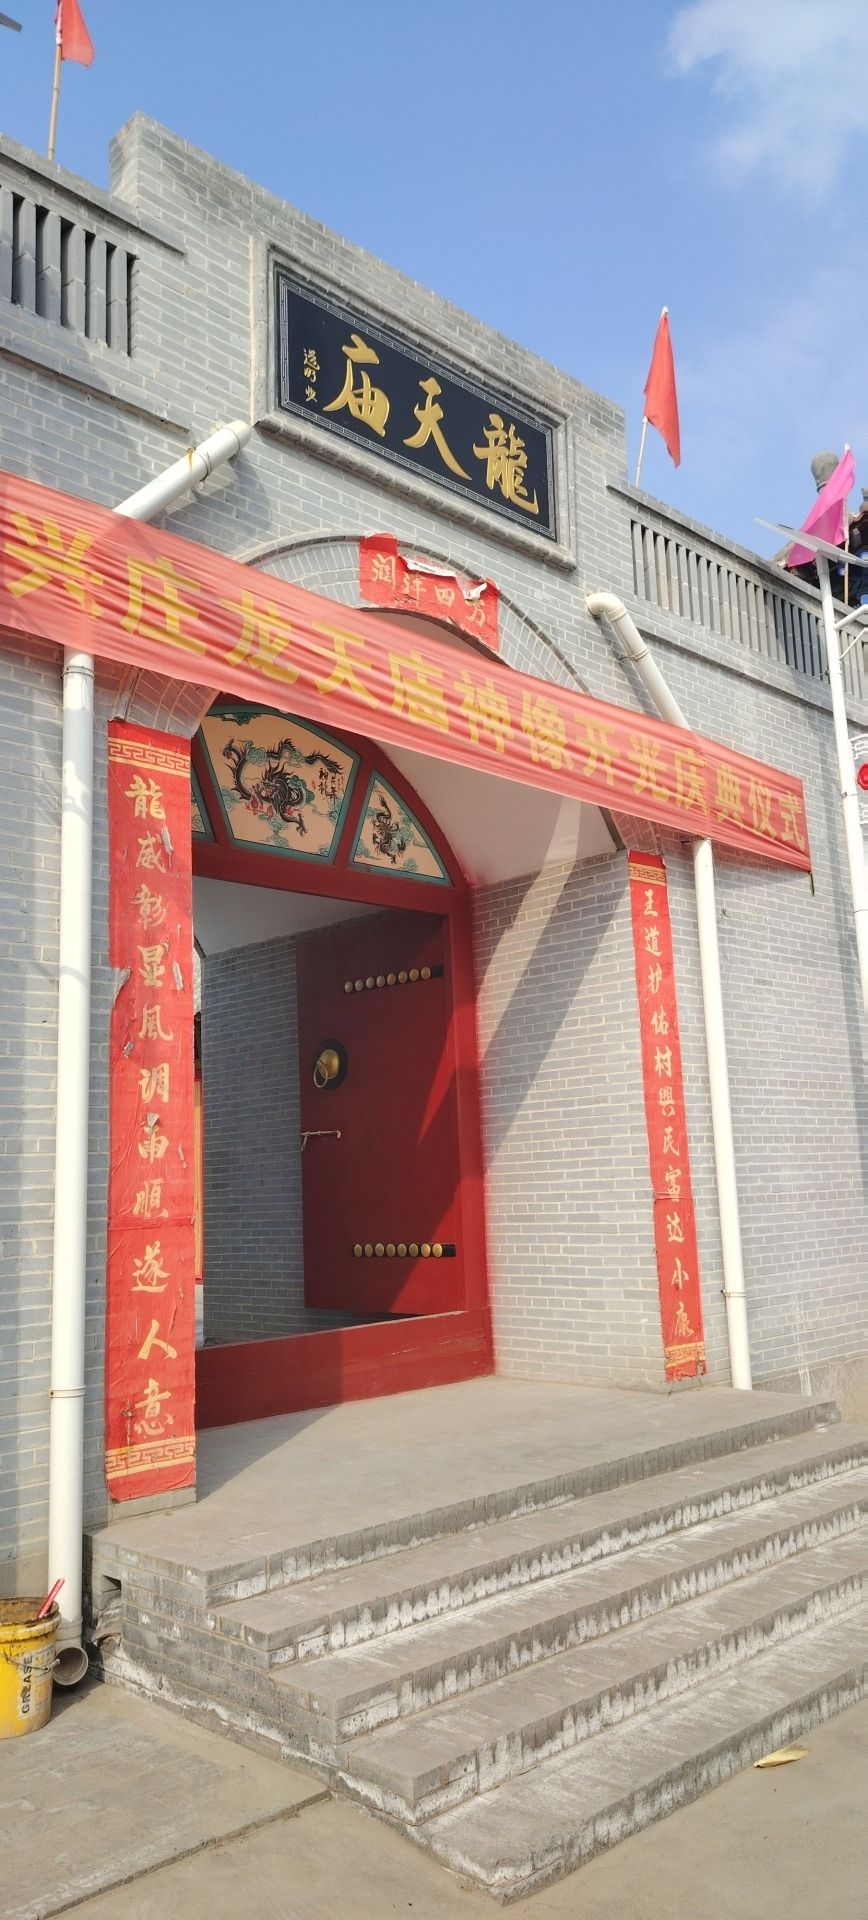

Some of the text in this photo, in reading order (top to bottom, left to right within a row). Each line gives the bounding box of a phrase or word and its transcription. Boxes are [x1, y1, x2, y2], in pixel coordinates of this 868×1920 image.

[322, 334, 539, 515] 龍天庙
[4, 510, 806, 853] 兴庄龙天庙神像开光庆典仪式
[21, 1655, 33, 1714] GREASE
